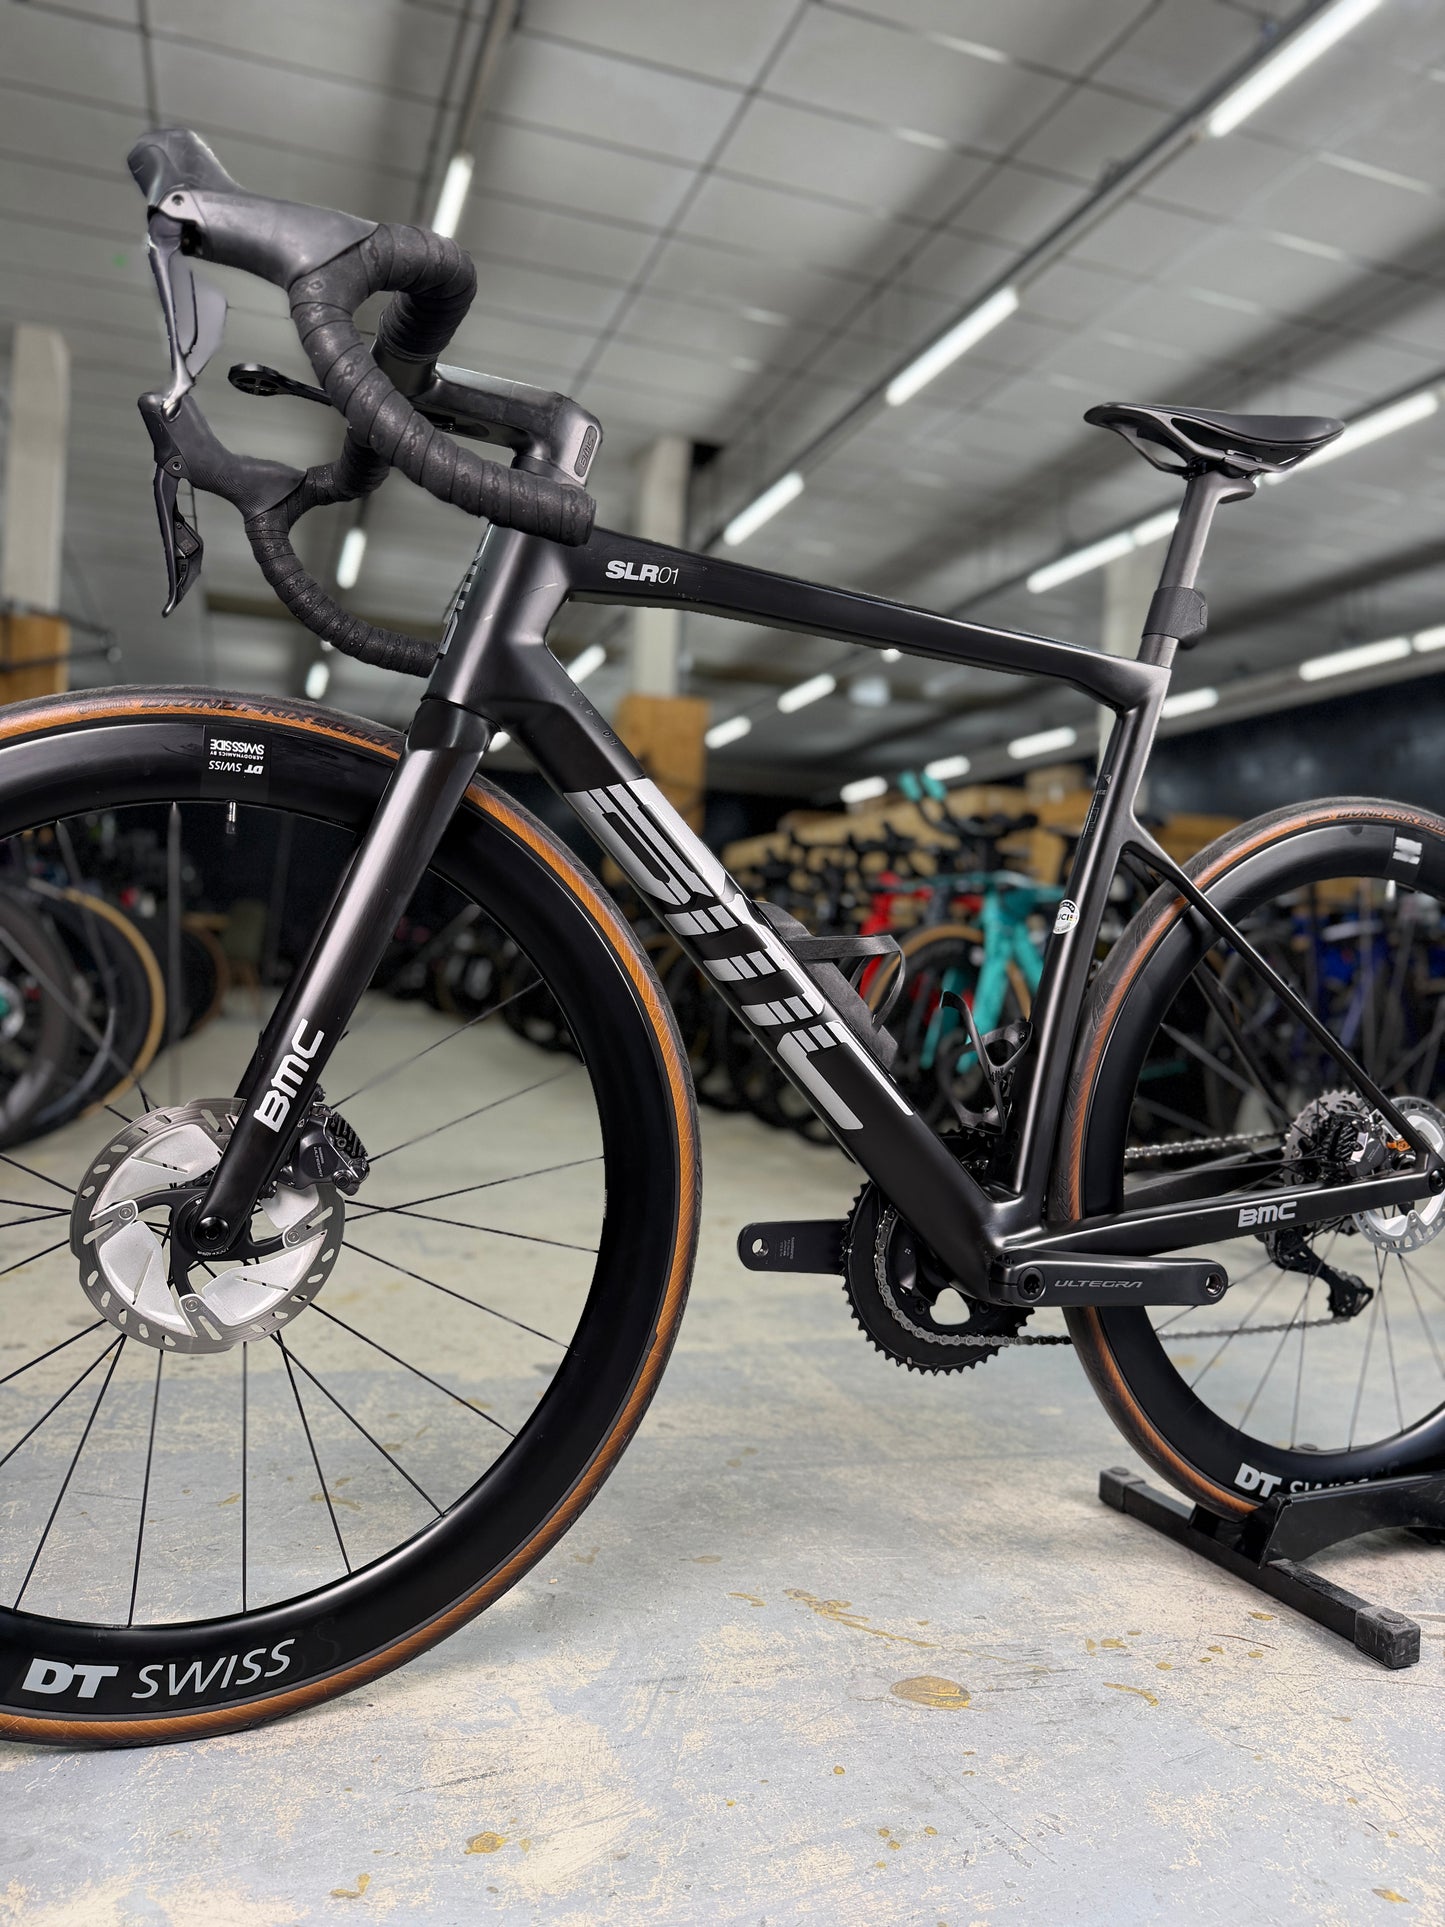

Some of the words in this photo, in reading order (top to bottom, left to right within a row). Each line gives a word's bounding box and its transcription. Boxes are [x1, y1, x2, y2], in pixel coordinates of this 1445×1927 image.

[605, 560, 679, 585] SLR01
[208, 760, 243, 773] SWISS
[218, 751, 264, 761] AERODYNAMICS
[244, 764, 264, 775] DT
[253, 1018, 325, 1133] BMC
[1238, 1201, 1298, 1228] BMC
[1054, 1279, 1144, 1289] ULTEGRA
[1234, 1462, 1283, 1499] DT
[22, 1657, 120, 1700] DT
[131, 1638, 296, 1700] SWISS
